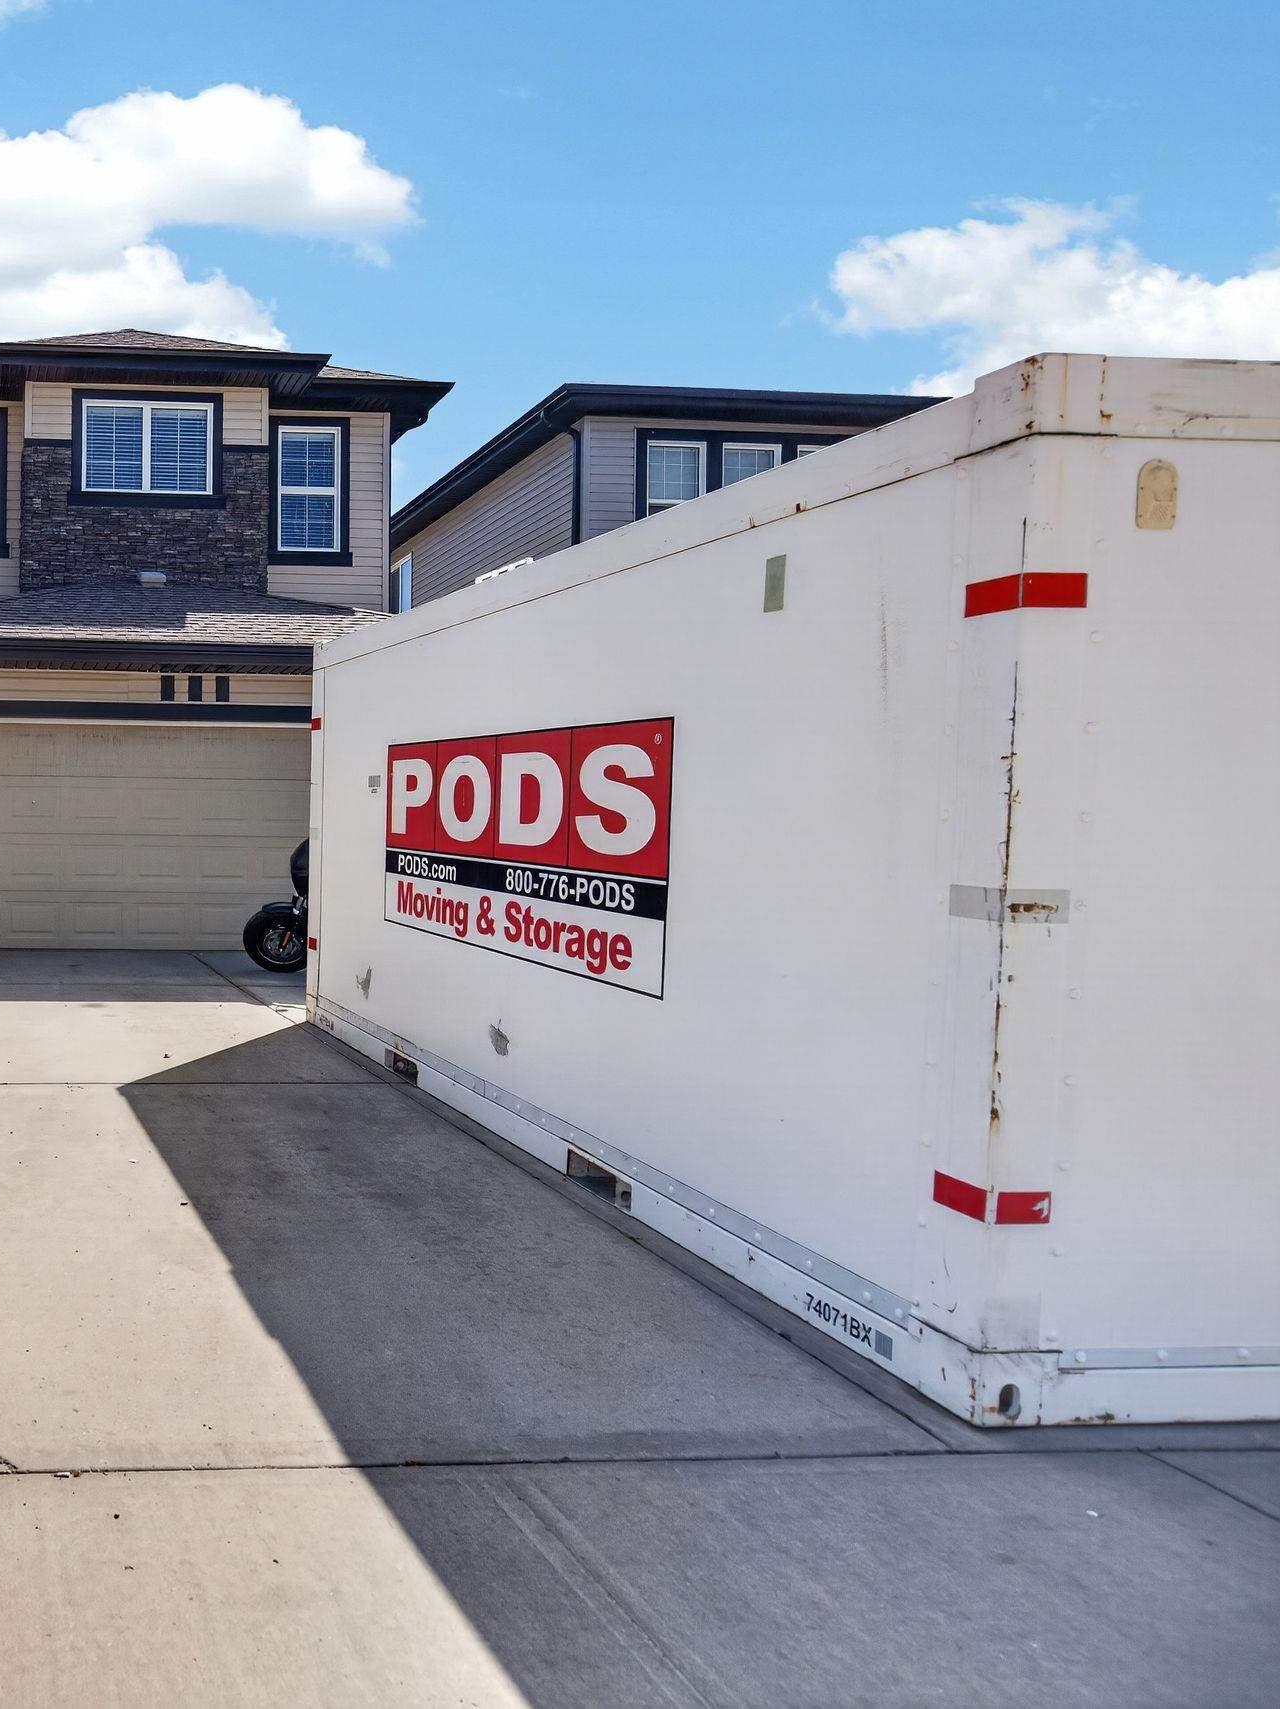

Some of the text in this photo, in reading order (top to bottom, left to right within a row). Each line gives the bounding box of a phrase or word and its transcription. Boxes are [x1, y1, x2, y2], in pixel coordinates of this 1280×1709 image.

[391, 744, 656, 856] PODS
[397, 854, 635, 911] PODS.com 800-776-PODS
[396, 880, 632, 975] Moving & Storage
[805, 1292, 872, 1348] 74071BX
